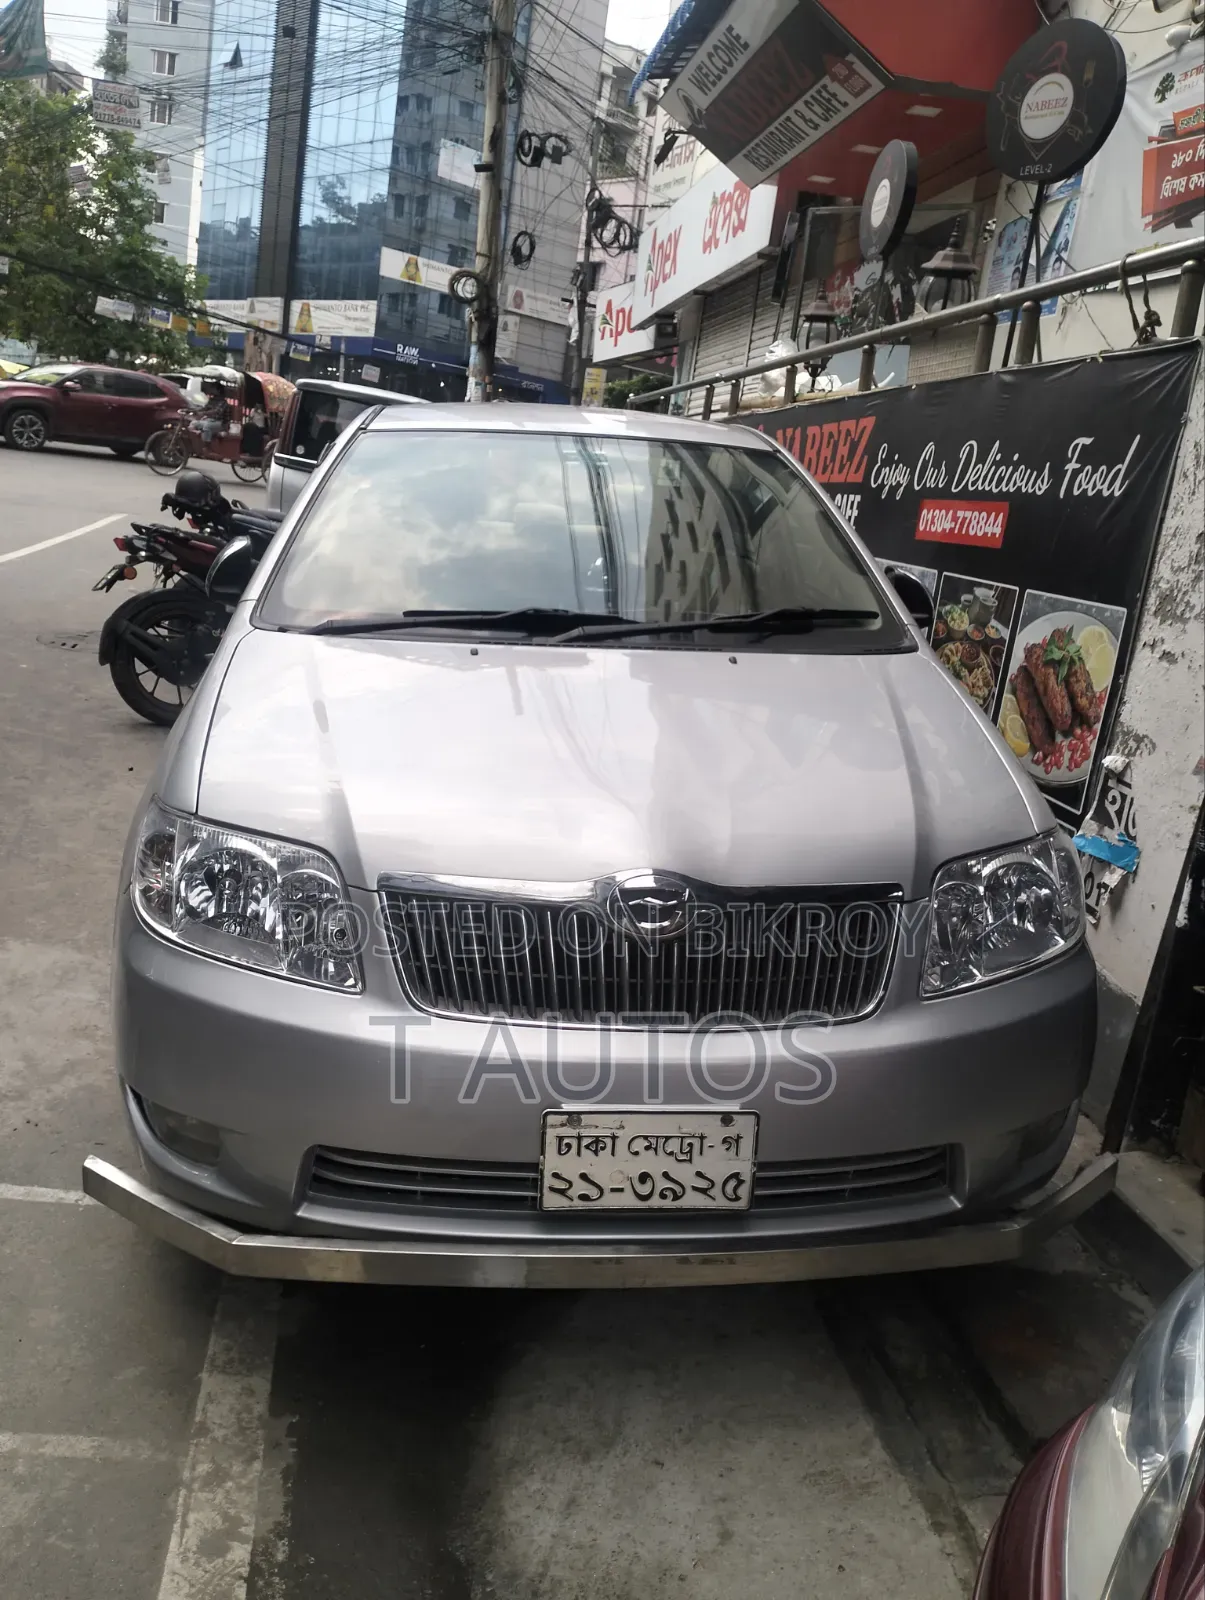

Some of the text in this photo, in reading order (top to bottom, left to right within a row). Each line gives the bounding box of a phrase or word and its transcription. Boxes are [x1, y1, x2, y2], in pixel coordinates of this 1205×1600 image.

[688, 24, 751, 97] WELCOME
[1025, 96, 1069, 114] NABEEZ
[742, 115, 810, 173] RESTAURANT
[803, 83, 850, 125] CAFE
[1020, 163, 1053, 176] LEVEL-2
[1160, 175, 1188, 200] বিশেষ
[644, 224, 683, 308] Apex
[871, 434, 1141, 500] Enjoy Our Delicious Food
[919, 508, 1004, 538] 01304-778844
[555, 1131, 619, 1158] ঢাকা
[548, 1170, 746, 1202] ২১-৩৯২৫
